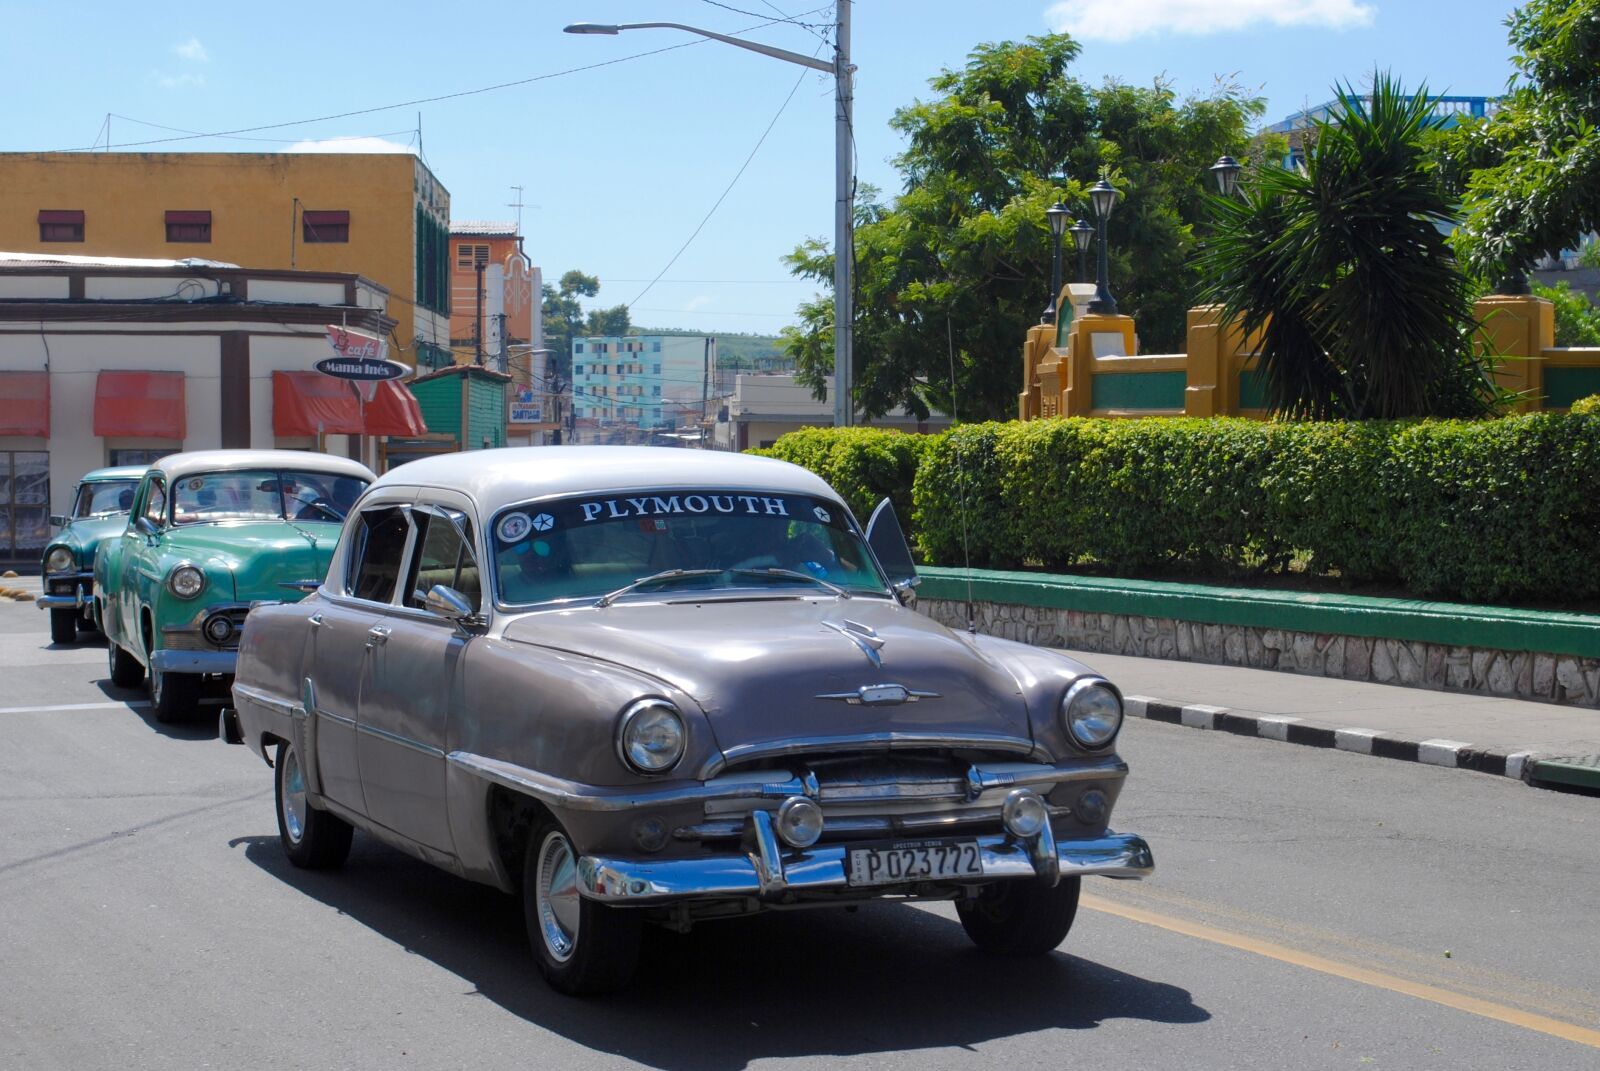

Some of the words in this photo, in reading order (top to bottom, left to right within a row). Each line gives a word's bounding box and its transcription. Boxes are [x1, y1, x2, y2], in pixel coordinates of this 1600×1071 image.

[347, 341, 375, 362] café
[325, 361, 361, 374] Mama
[364, 361, 390, 376] Inés
[580, 495, 790, 522] PLYMOUTH
[866, 846, 979, 881] P023772
